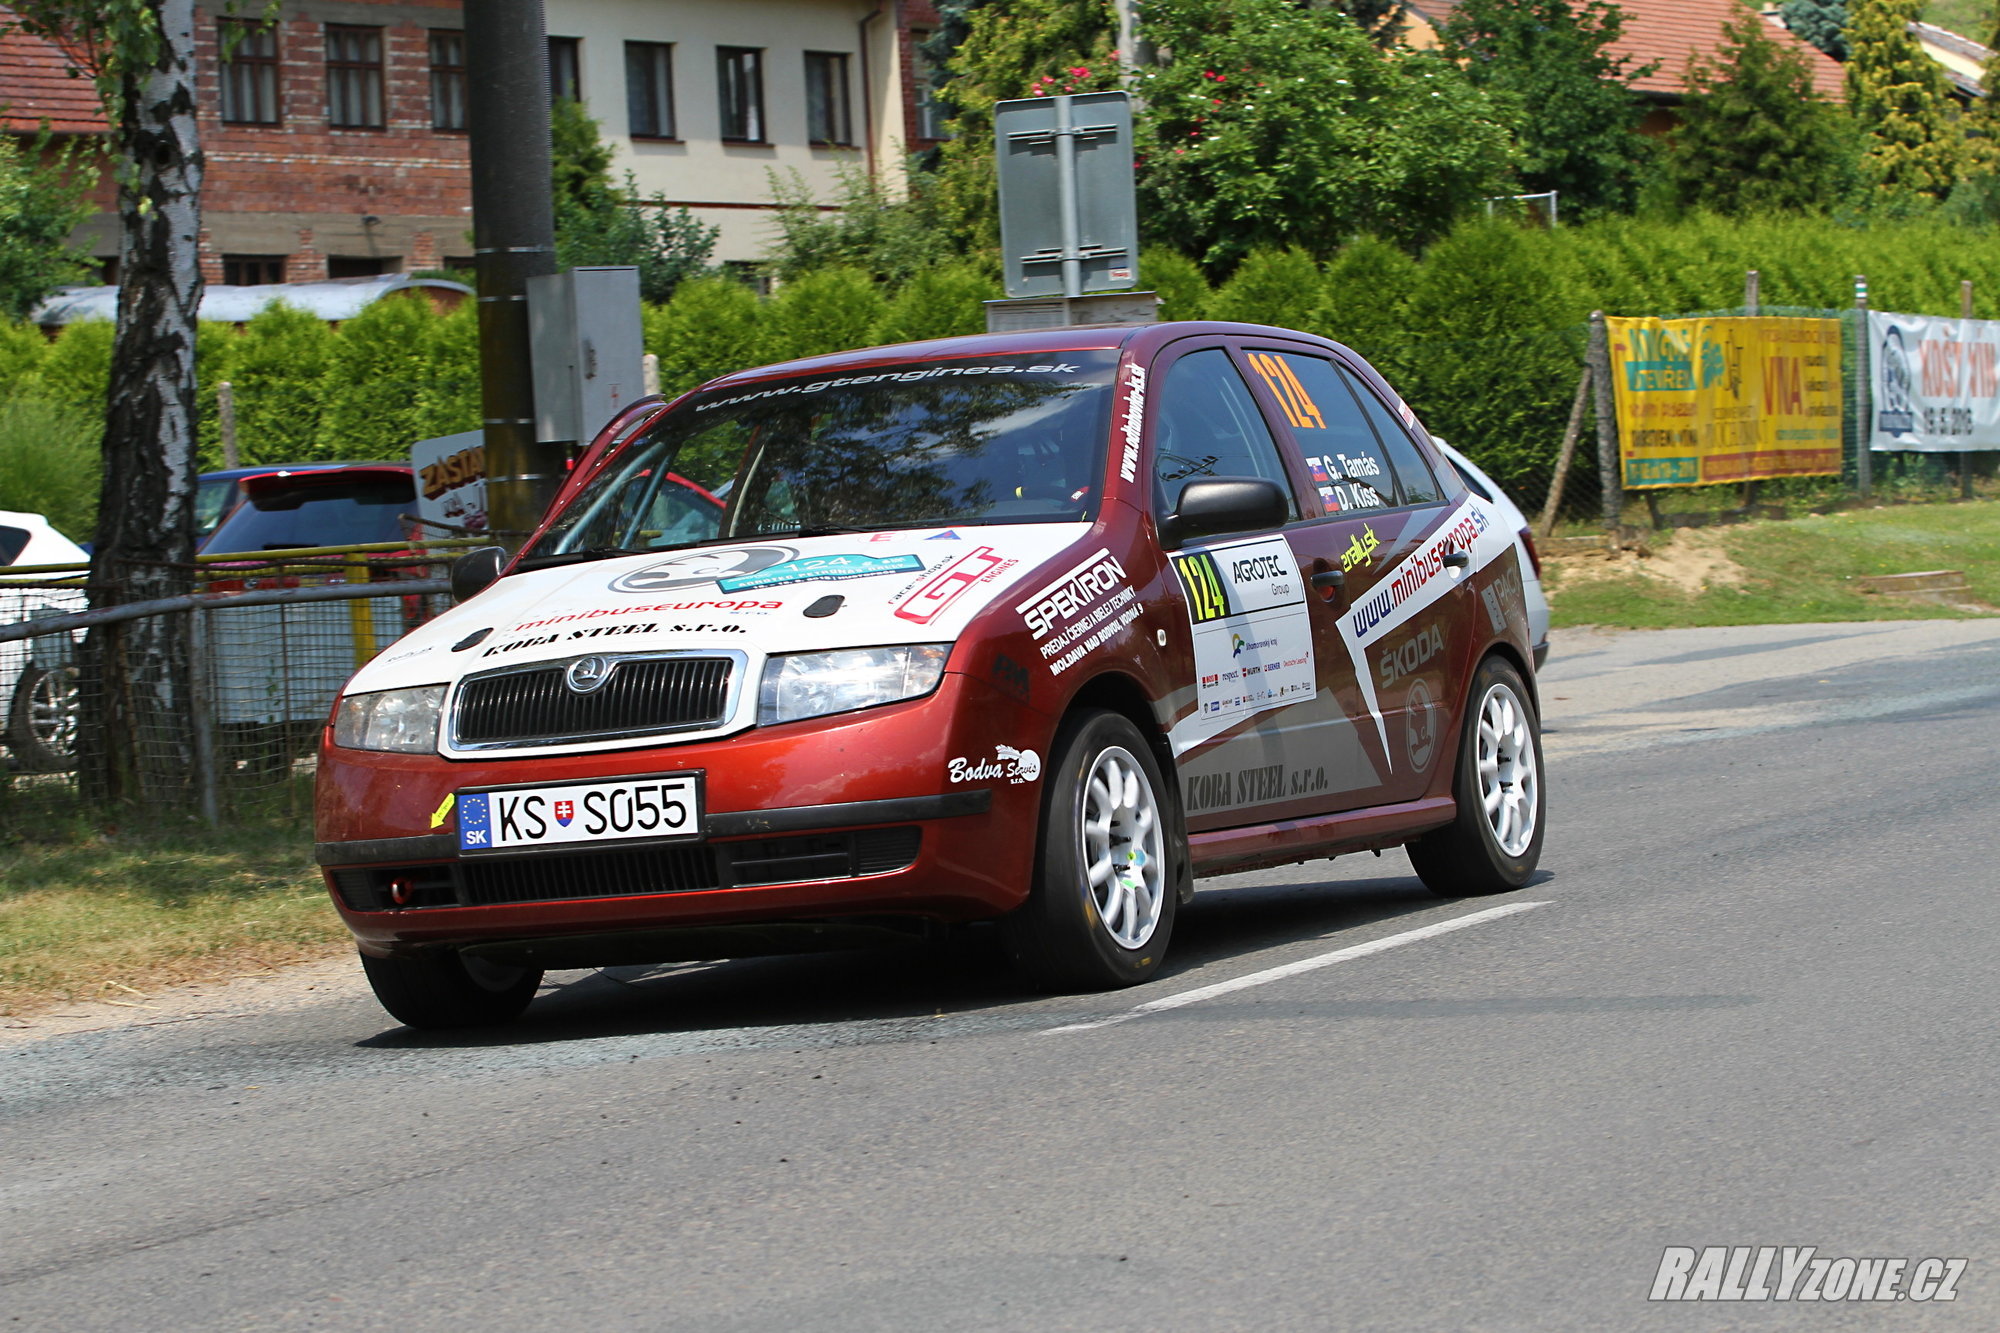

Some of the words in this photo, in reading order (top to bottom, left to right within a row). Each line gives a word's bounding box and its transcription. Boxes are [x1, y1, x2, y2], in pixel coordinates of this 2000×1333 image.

[1918, 327, 1961, 397] KOŠT
[695, 363, 1081, 412] www.gtengines.sk
[1248, 353, 1327, 429] 124
[1323, 455, 1342, 480] G.
[1337, 451, 1380, 478] Tamás
[1334, 485, 1354, 511] D.
[1349, 482, 1380, 509] Kiss
[784, 557, 851, 572] 124
[888, 554, 956, 605] race-shop.sk
[980, 558, 1019, 583] ENGINES
[1233, 555, 1287, 584] AGROTEC
[1015, 547, 1126, 640] SPEKTRON
[1178, 554, 1225, 621] 124
[1271, 583, 1290, 596] Group
[514, 600, 784, 631] minibuseuropa
[1040, 634, 1070, 659] PREDAJ
[1067, 614, 1094, 641] ČIERNEJ
[1095, 602, 1113, 622] BIELEJ
[1111, 585, 1136, 611] TECHNIKY
[482, 633, 559, 657] KOBA
[567, 622, 659, 640] STEEL
[670, 623, 747, 634] s.r.o.
[1049, 645, 1088, 676] MOLDAVA
[1084, 632, 1101, 652] NAD
[1097, 620, 1124, 643] BODVOU,
[1119, 603, 1140, 624] VODNÁ
[1137, 602, 1144, 614] 9
[1380, 623, 1444, 689] ŠKODA
[948, 757, 1004, 783] Bodva
[1006, 762, 1037, 778] Servis
[1187, 772, 1232, 811] KOBA
[1237, 764, 1286, 804] STEEL
[1291, 766, 1329, 795] s.r.o.
[499, 795, 547, 842] KS
[583, 783, 687, 835] S055
[466, 830, 487, 845] SK
